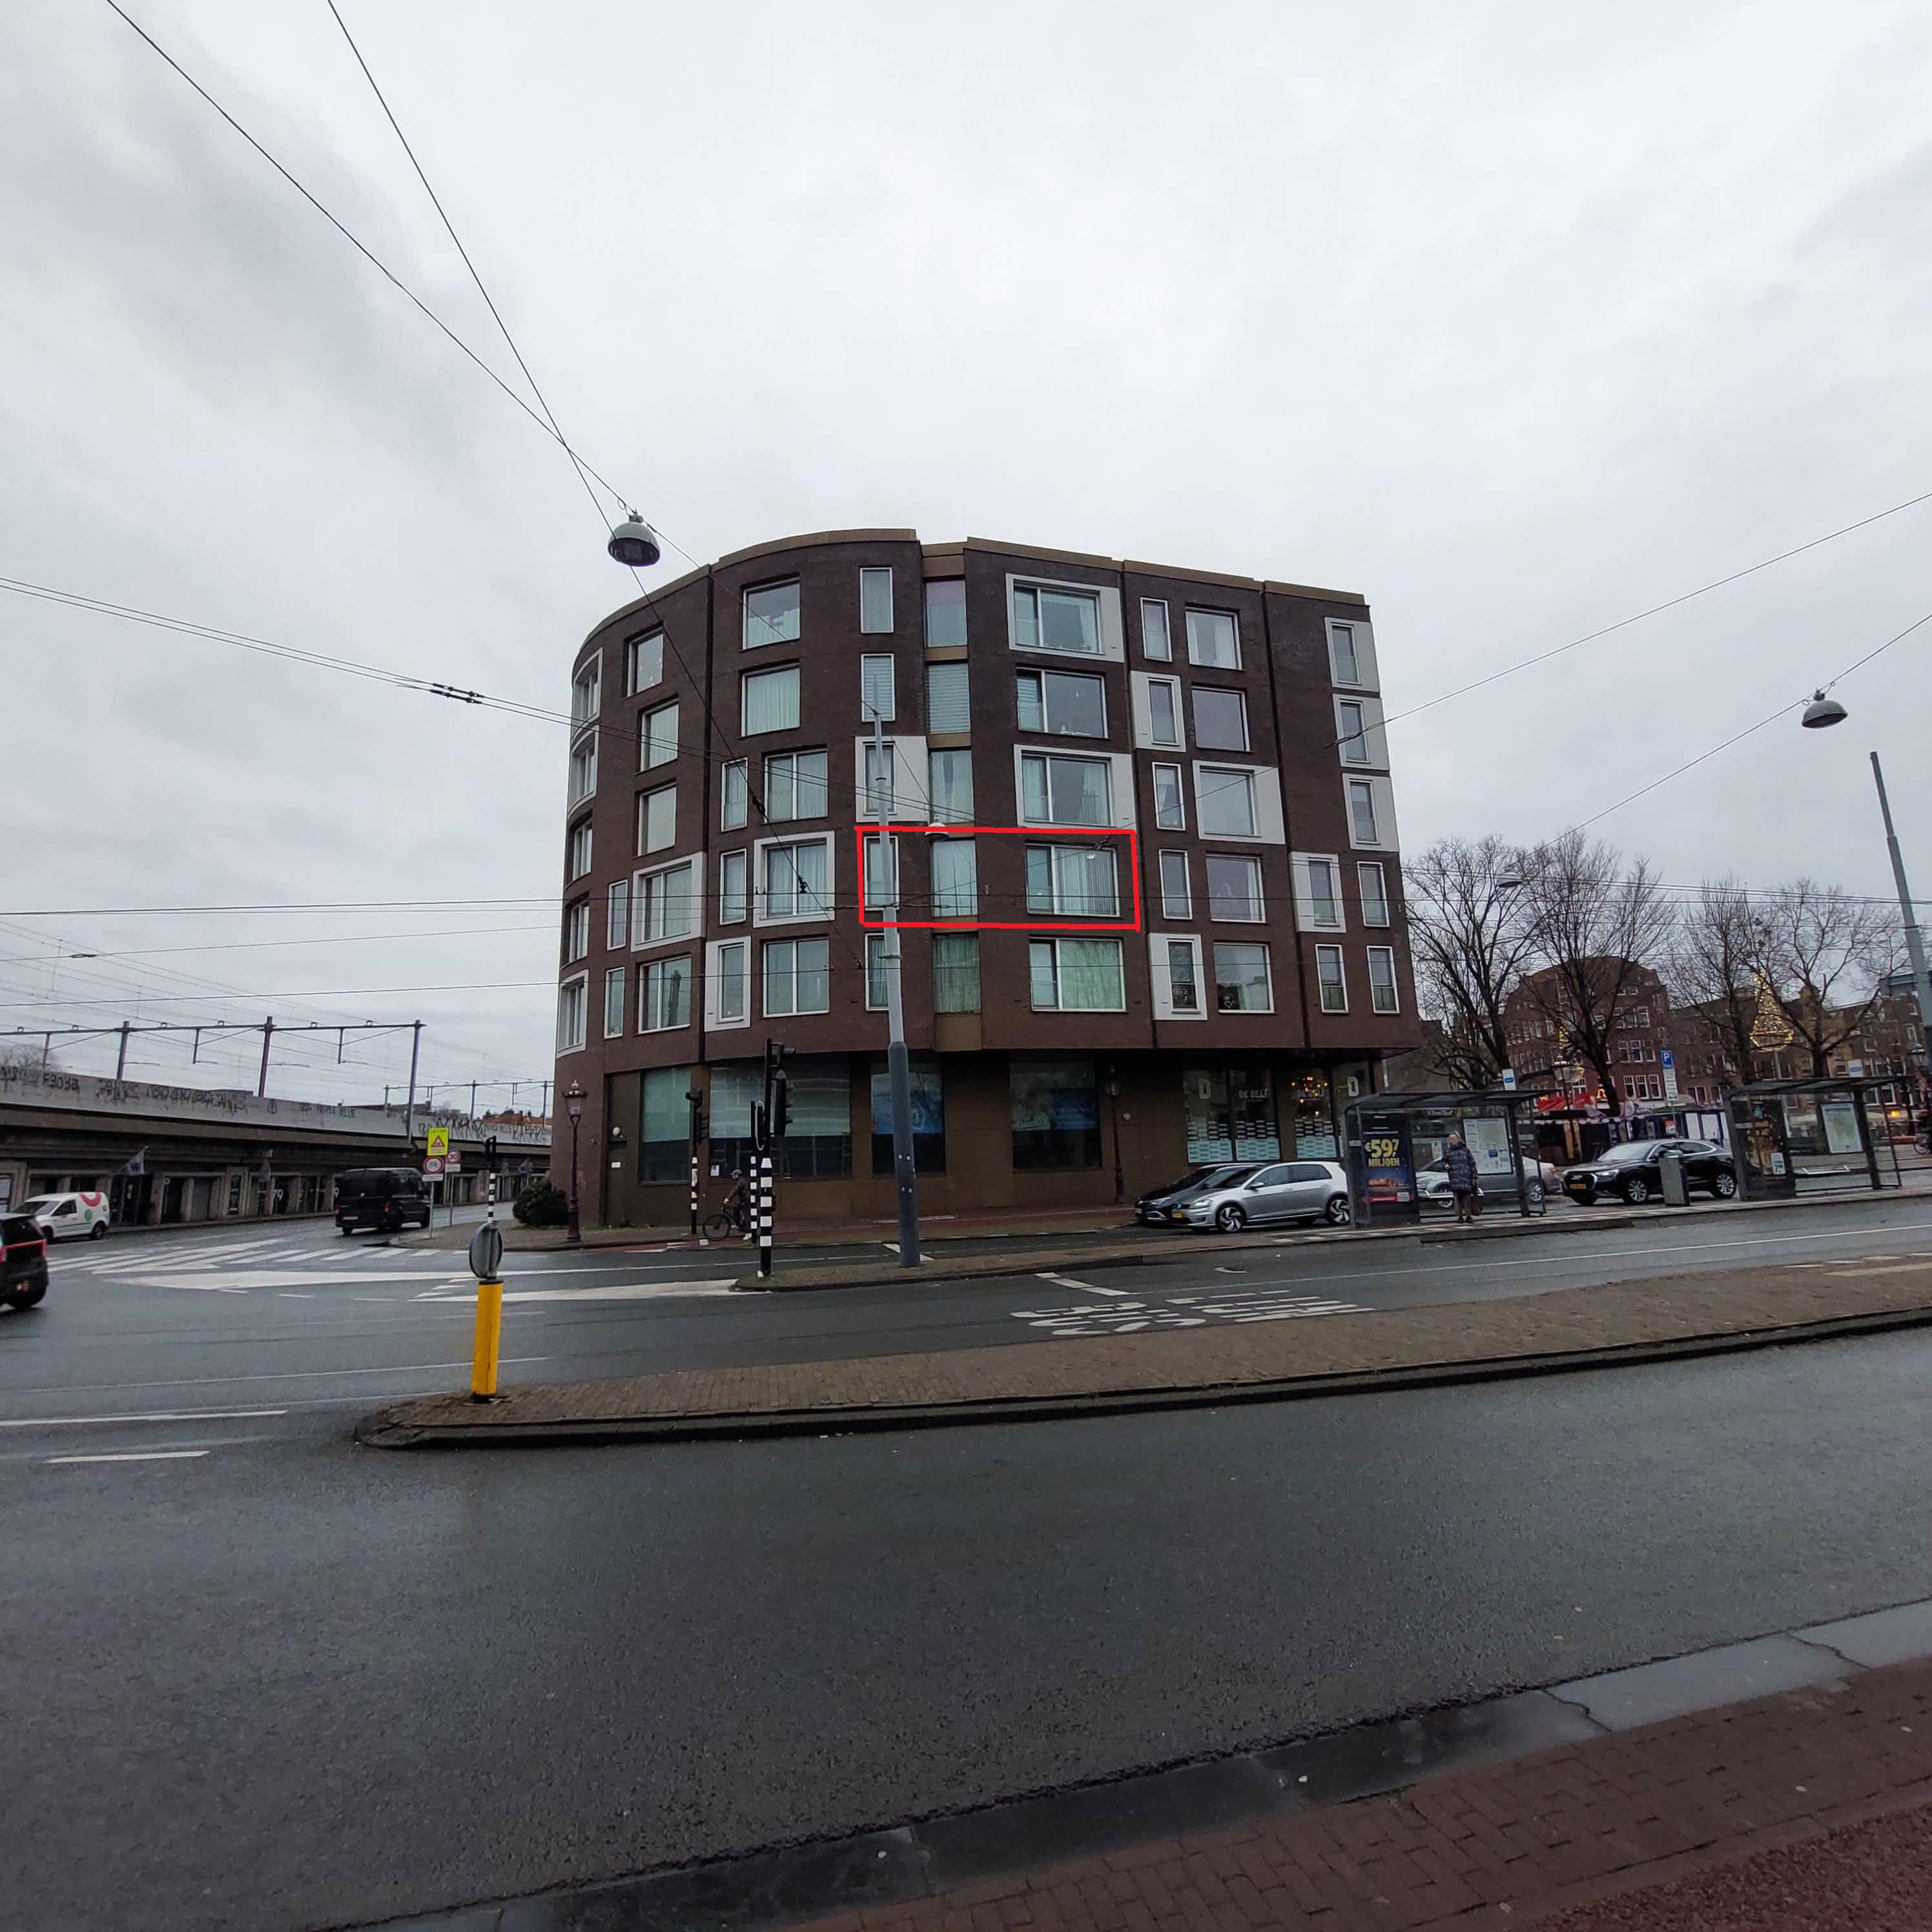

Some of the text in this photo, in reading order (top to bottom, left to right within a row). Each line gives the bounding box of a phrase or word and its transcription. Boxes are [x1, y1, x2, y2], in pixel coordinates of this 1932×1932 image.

[1663, 1053, 1670, 1062] P
[1347, 1076, 1359, 1096] D
[1368, 1157, 1400, 1167] MILJOEN
